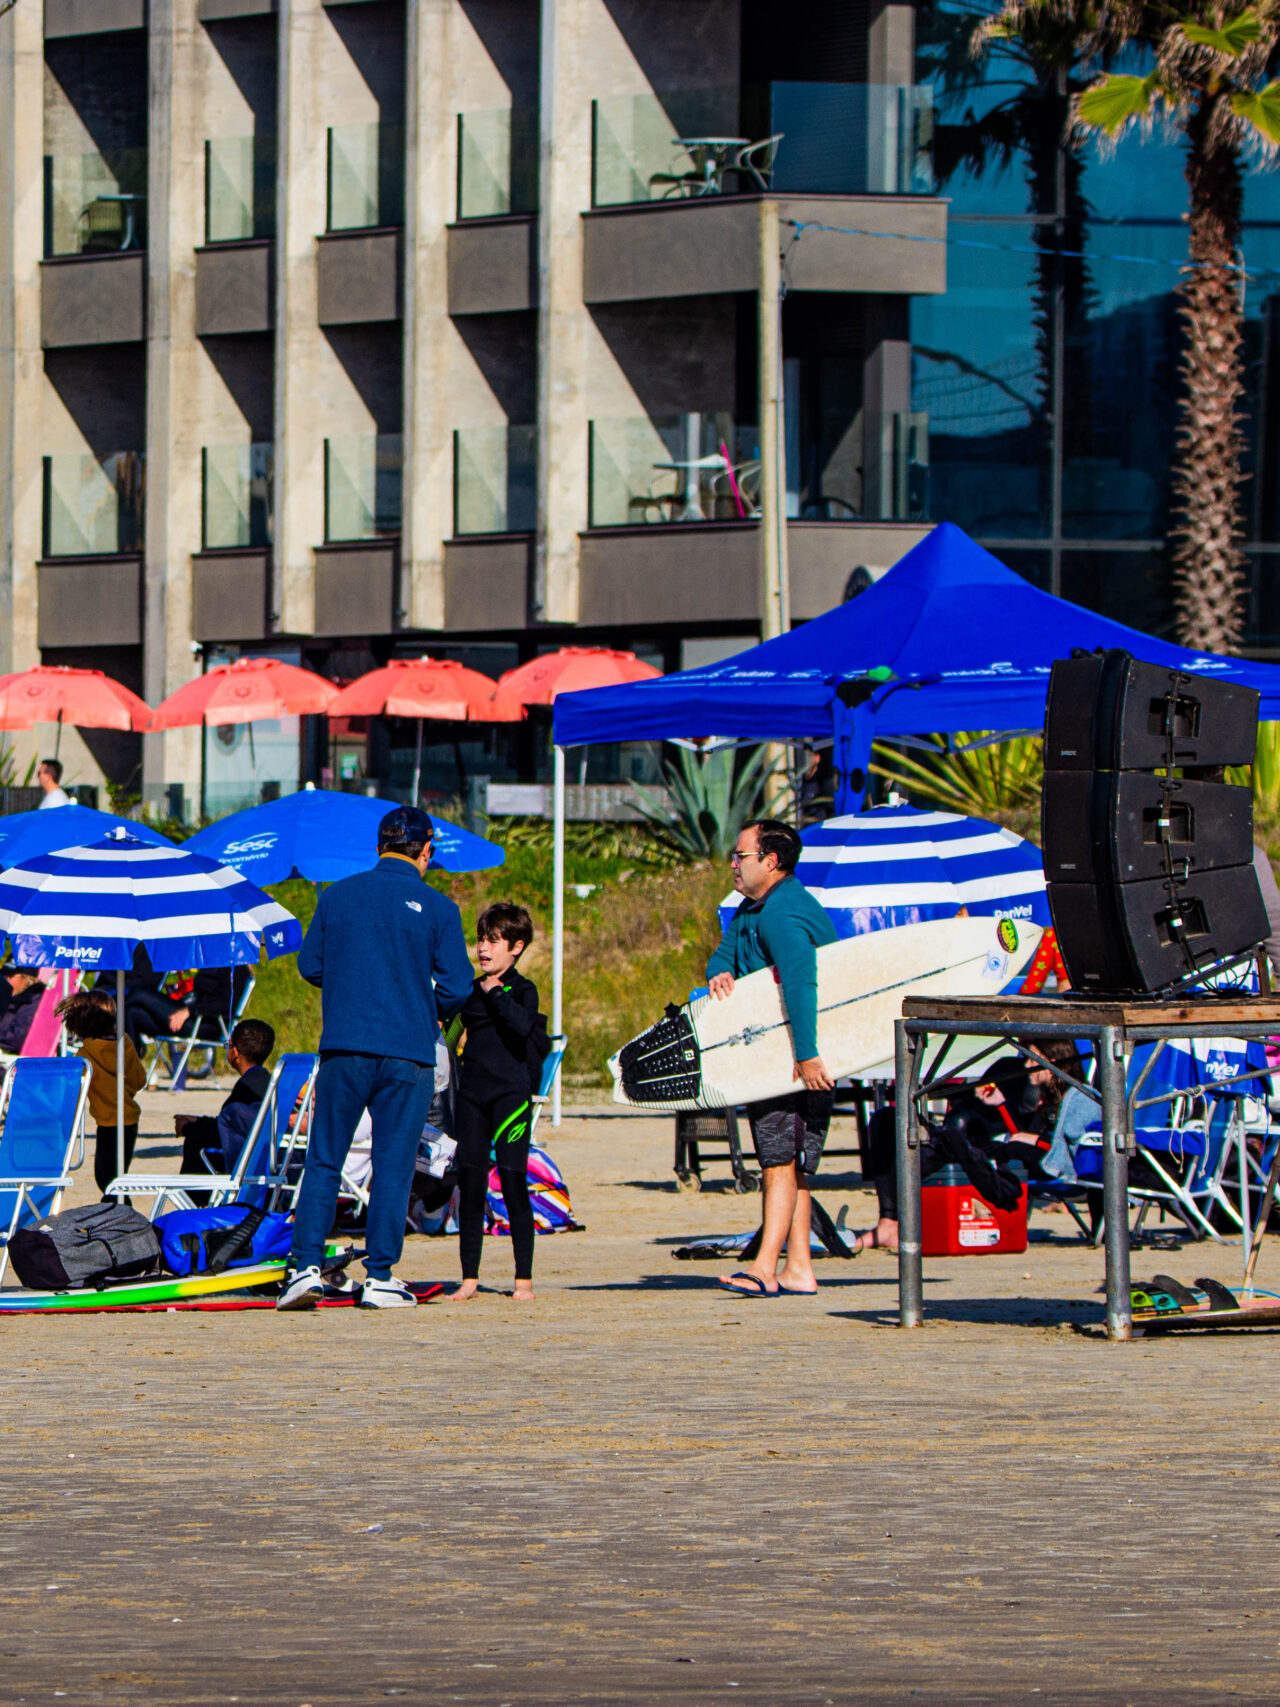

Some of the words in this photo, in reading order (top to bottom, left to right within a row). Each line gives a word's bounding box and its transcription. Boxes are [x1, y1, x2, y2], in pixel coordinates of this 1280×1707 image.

[222, 837, 278, 855] Sesc
[54, 945, 103, 959] PanVel
[1205, 1061, 1240, 1077] nVel
